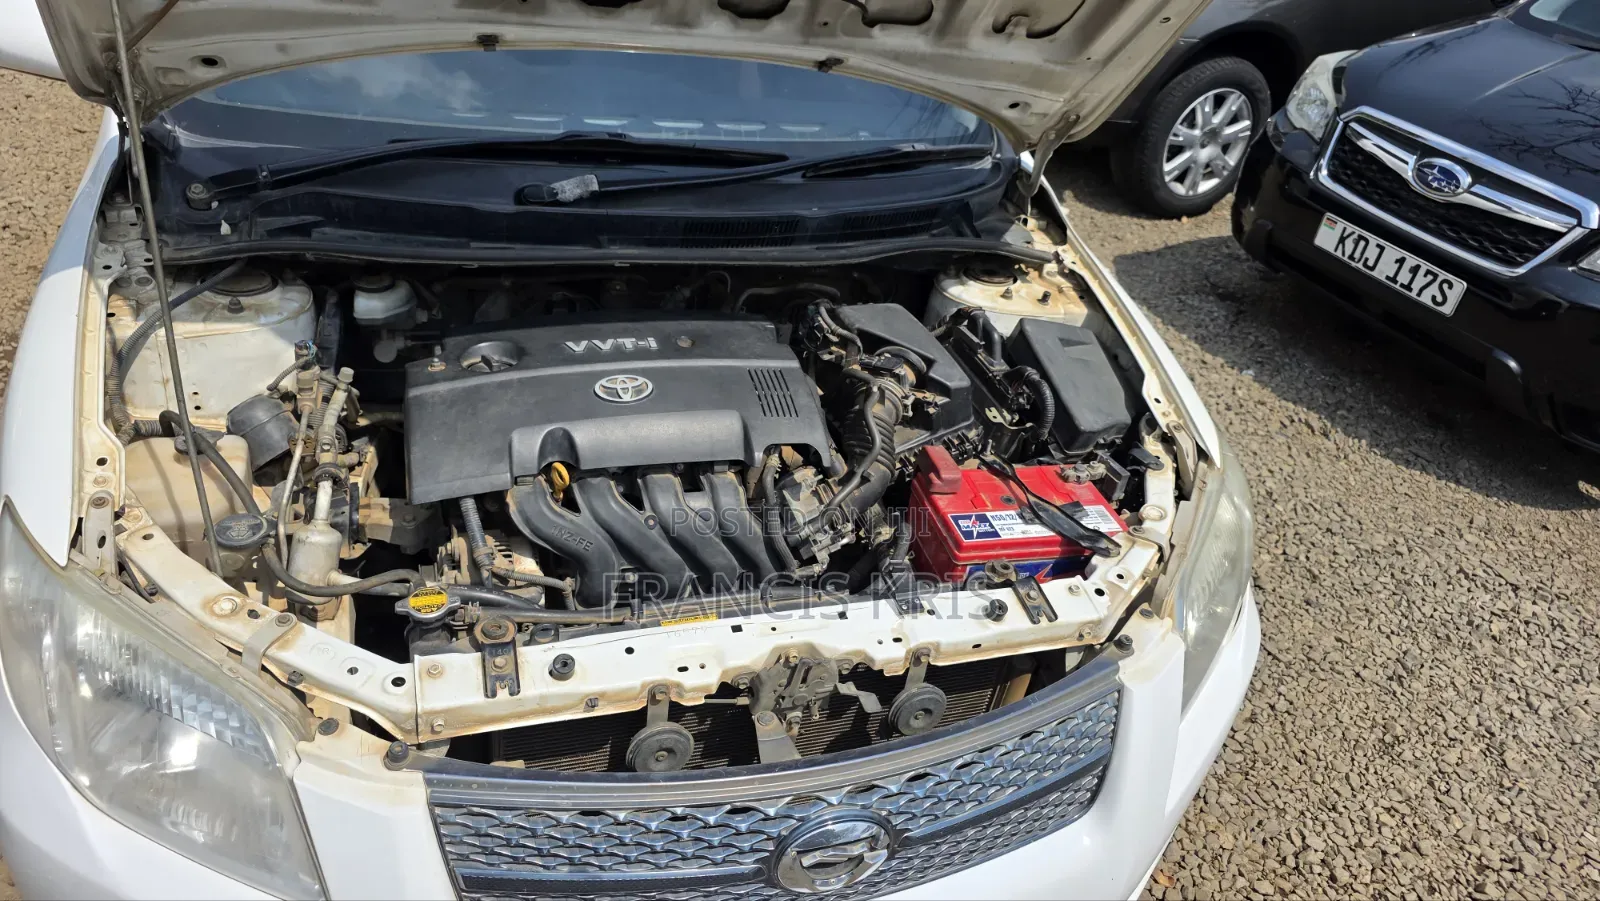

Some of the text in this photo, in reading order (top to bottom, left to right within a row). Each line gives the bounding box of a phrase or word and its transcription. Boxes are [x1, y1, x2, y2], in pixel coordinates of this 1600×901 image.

[1334, 227, 1454, 307] KDJ 117S
[564, 337, 659, 353] VVT-i
[551, 524, 594, 552] 1NZ-FE
